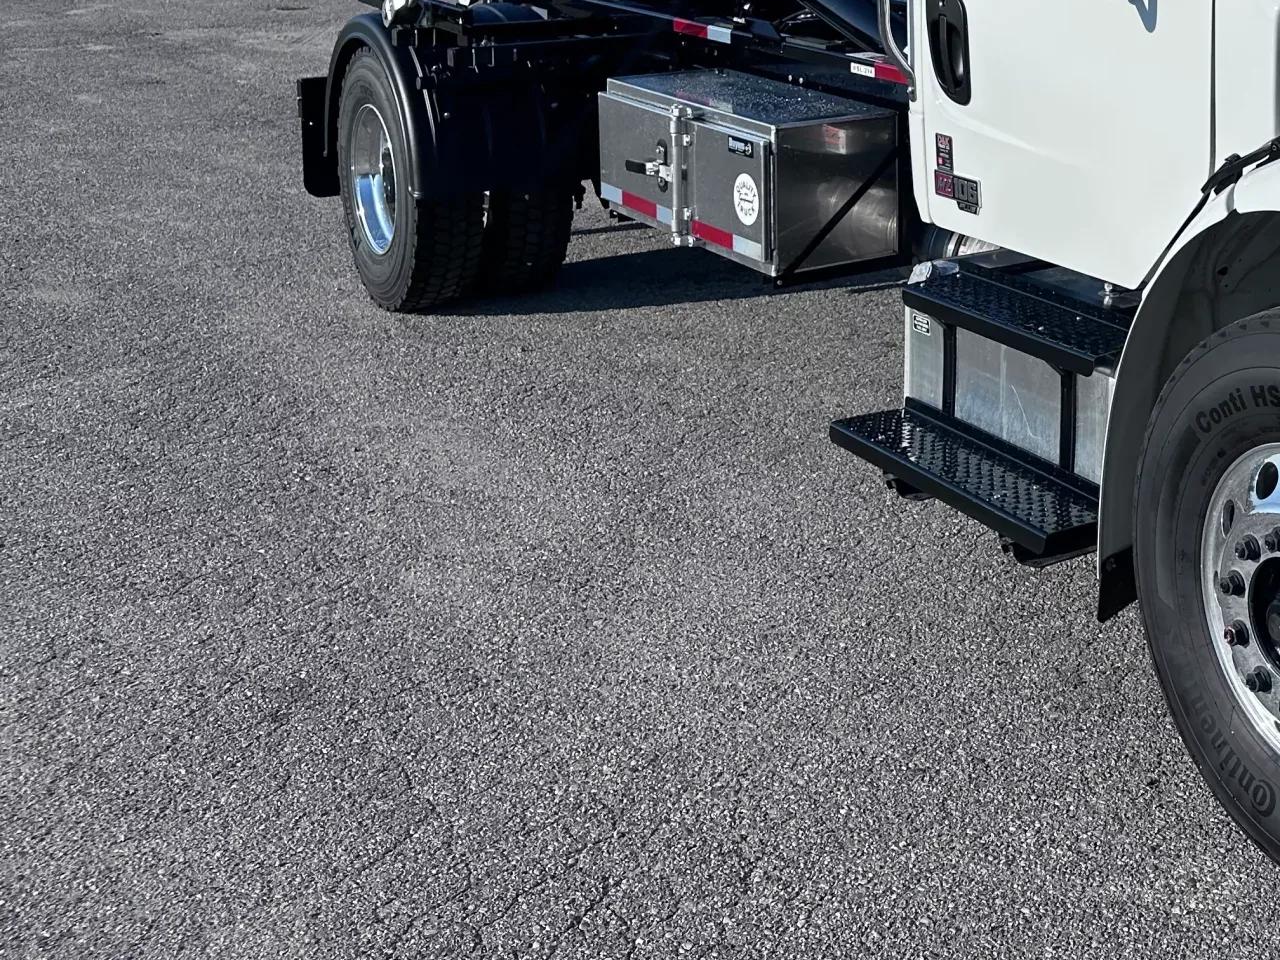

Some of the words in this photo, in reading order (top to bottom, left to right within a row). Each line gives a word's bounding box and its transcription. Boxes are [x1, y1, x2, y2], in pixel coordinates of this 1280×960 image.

[735, 180, 757, 198] QUALITY
[954, 178, 977, 203] 106
[737, 200, 755, 216] TRUCK
[1195, 387, 1247, 433] Conti
